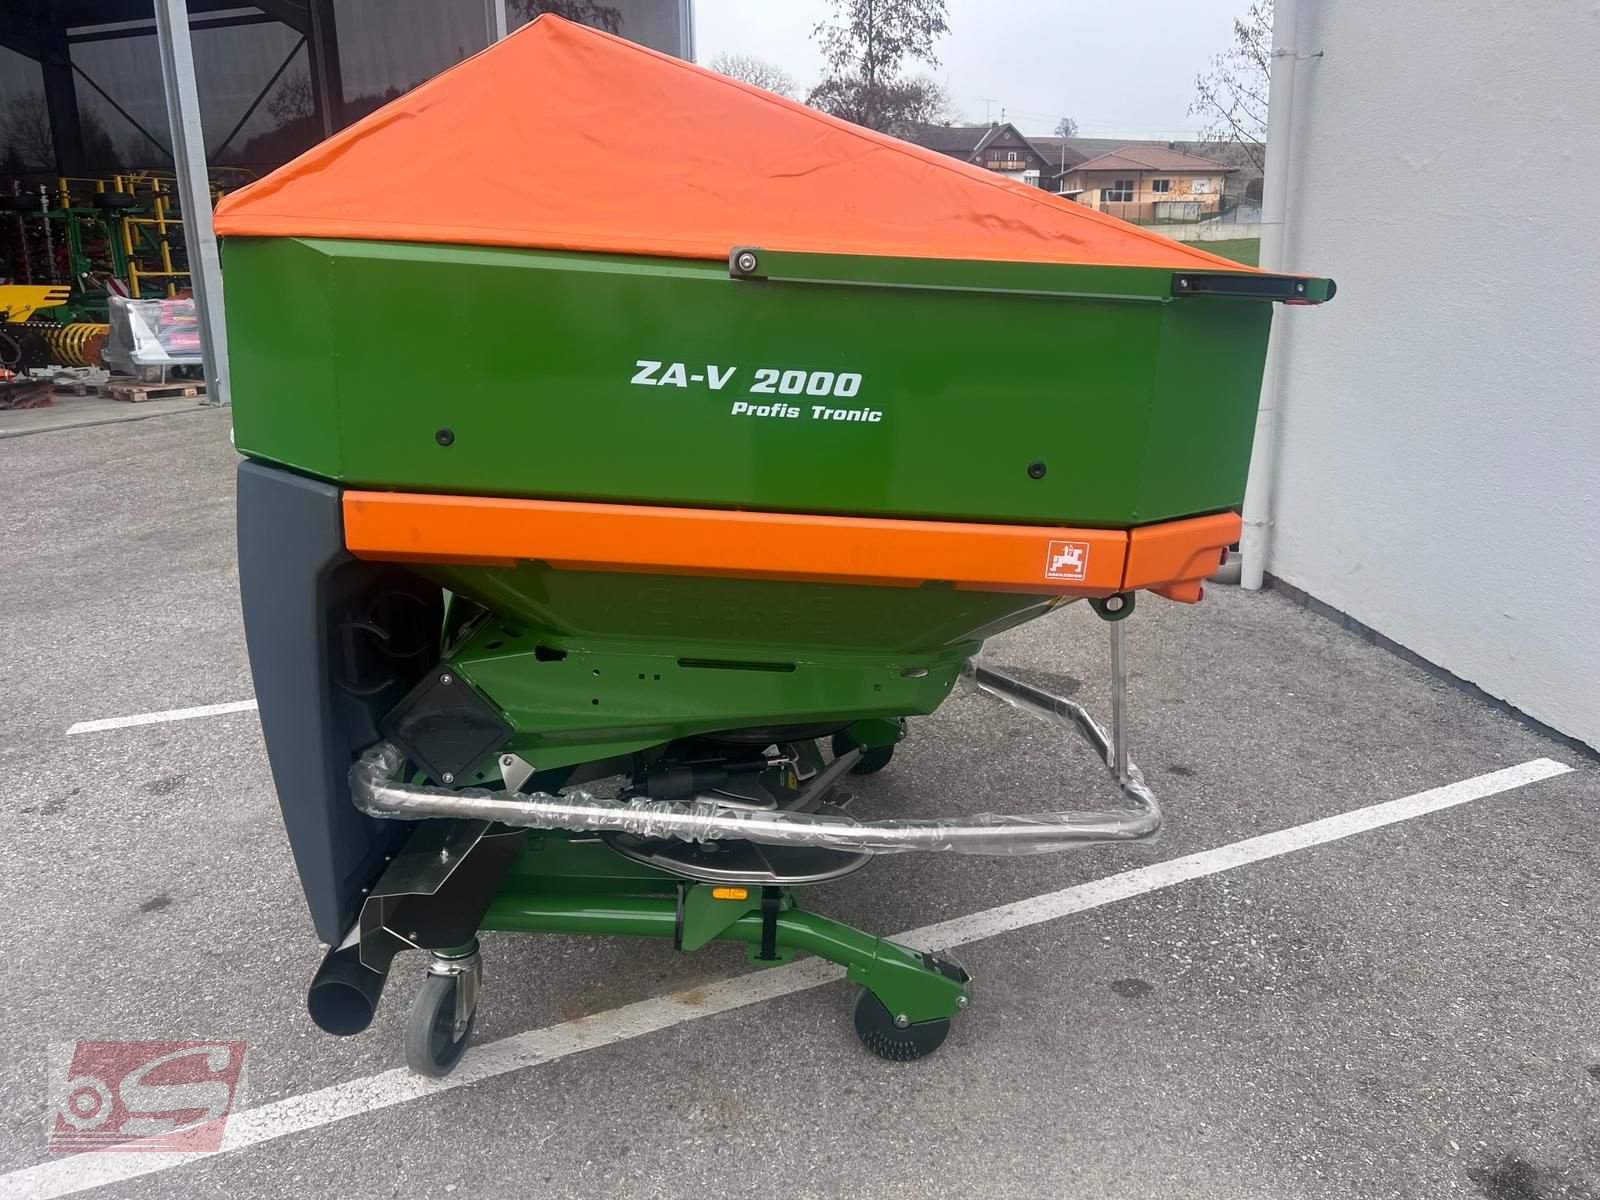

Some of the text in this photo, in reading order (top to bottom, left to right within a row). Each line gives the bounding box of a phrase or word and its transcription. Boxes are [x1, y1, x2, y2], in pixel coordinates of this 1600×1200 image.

[631, 360, 862, 397] ZA-V 2000
[731, 401, 883, 422] Profis Tronic
